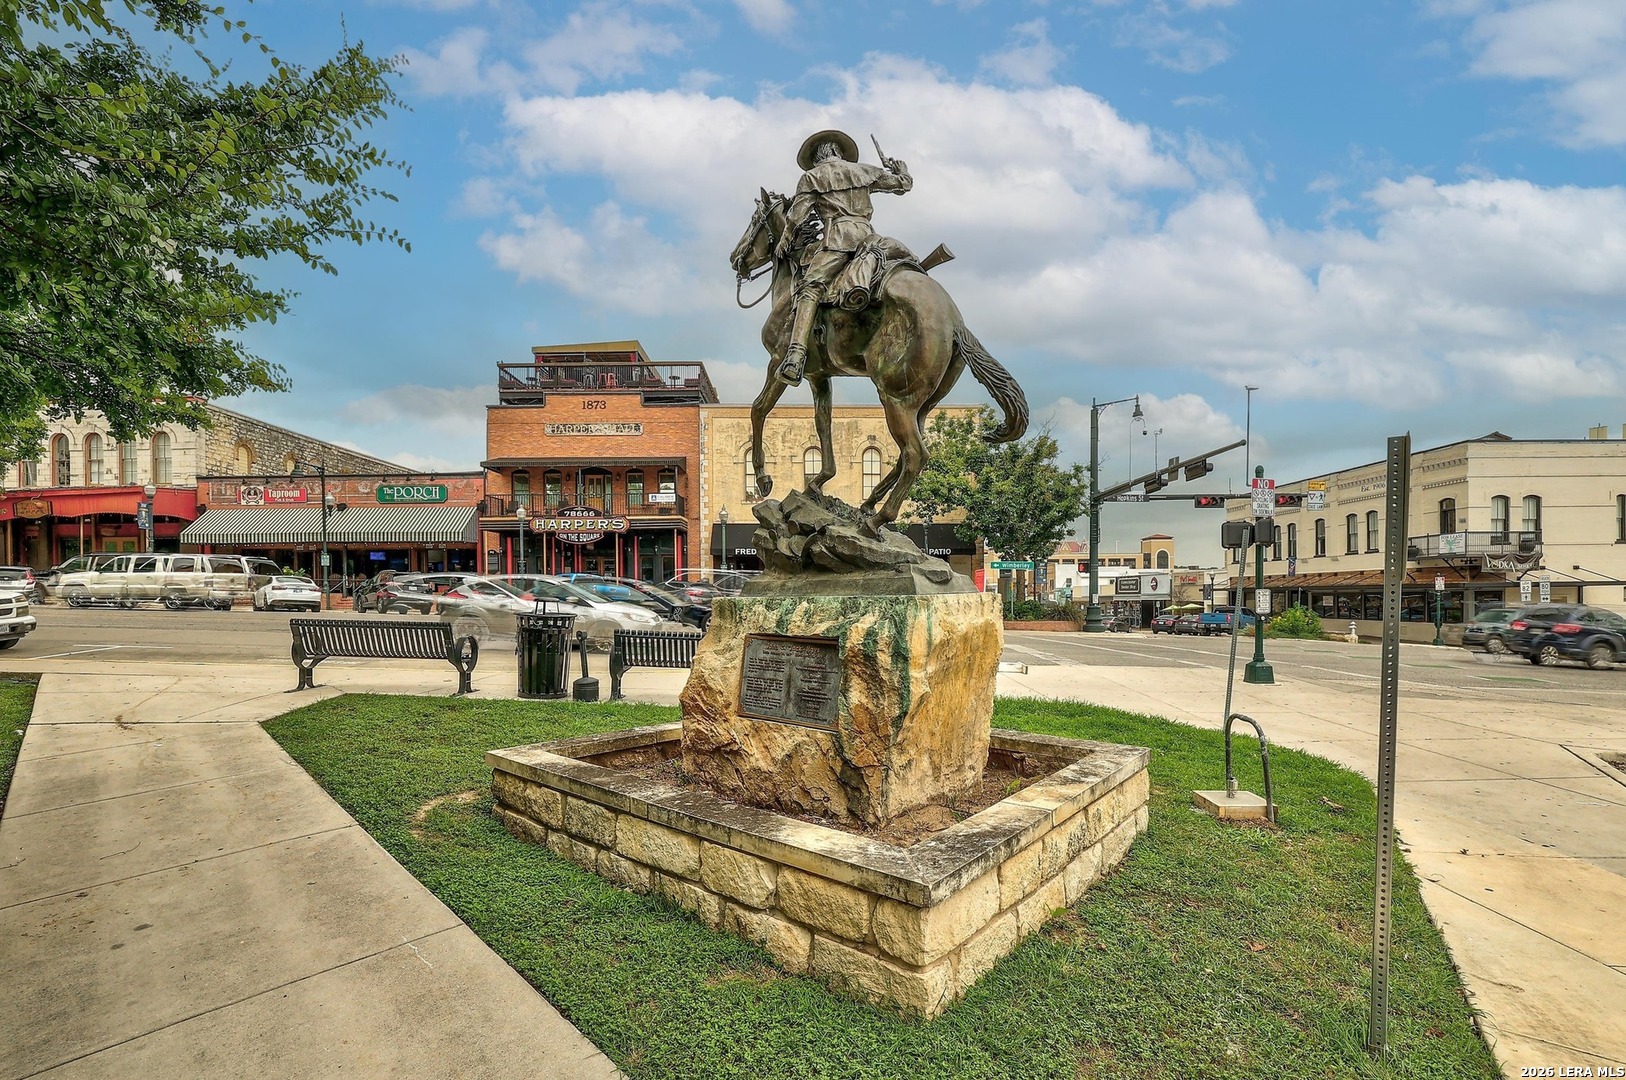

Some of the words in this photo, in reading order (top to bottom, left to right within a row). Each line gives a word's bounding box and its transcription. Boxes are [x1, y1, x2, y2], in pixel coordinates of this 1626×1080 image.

[581, 400, 607, 410] 1873
[1257, 479, 1270, 489] NO
[267, 489, 300, 498] Taproom
[394, 486, 440, 500] PORCH
[535, 519, 624, 529] HARPER'S
[568, 533, 579, 541] THE
[579, 533, 601, 541] SQUARE
